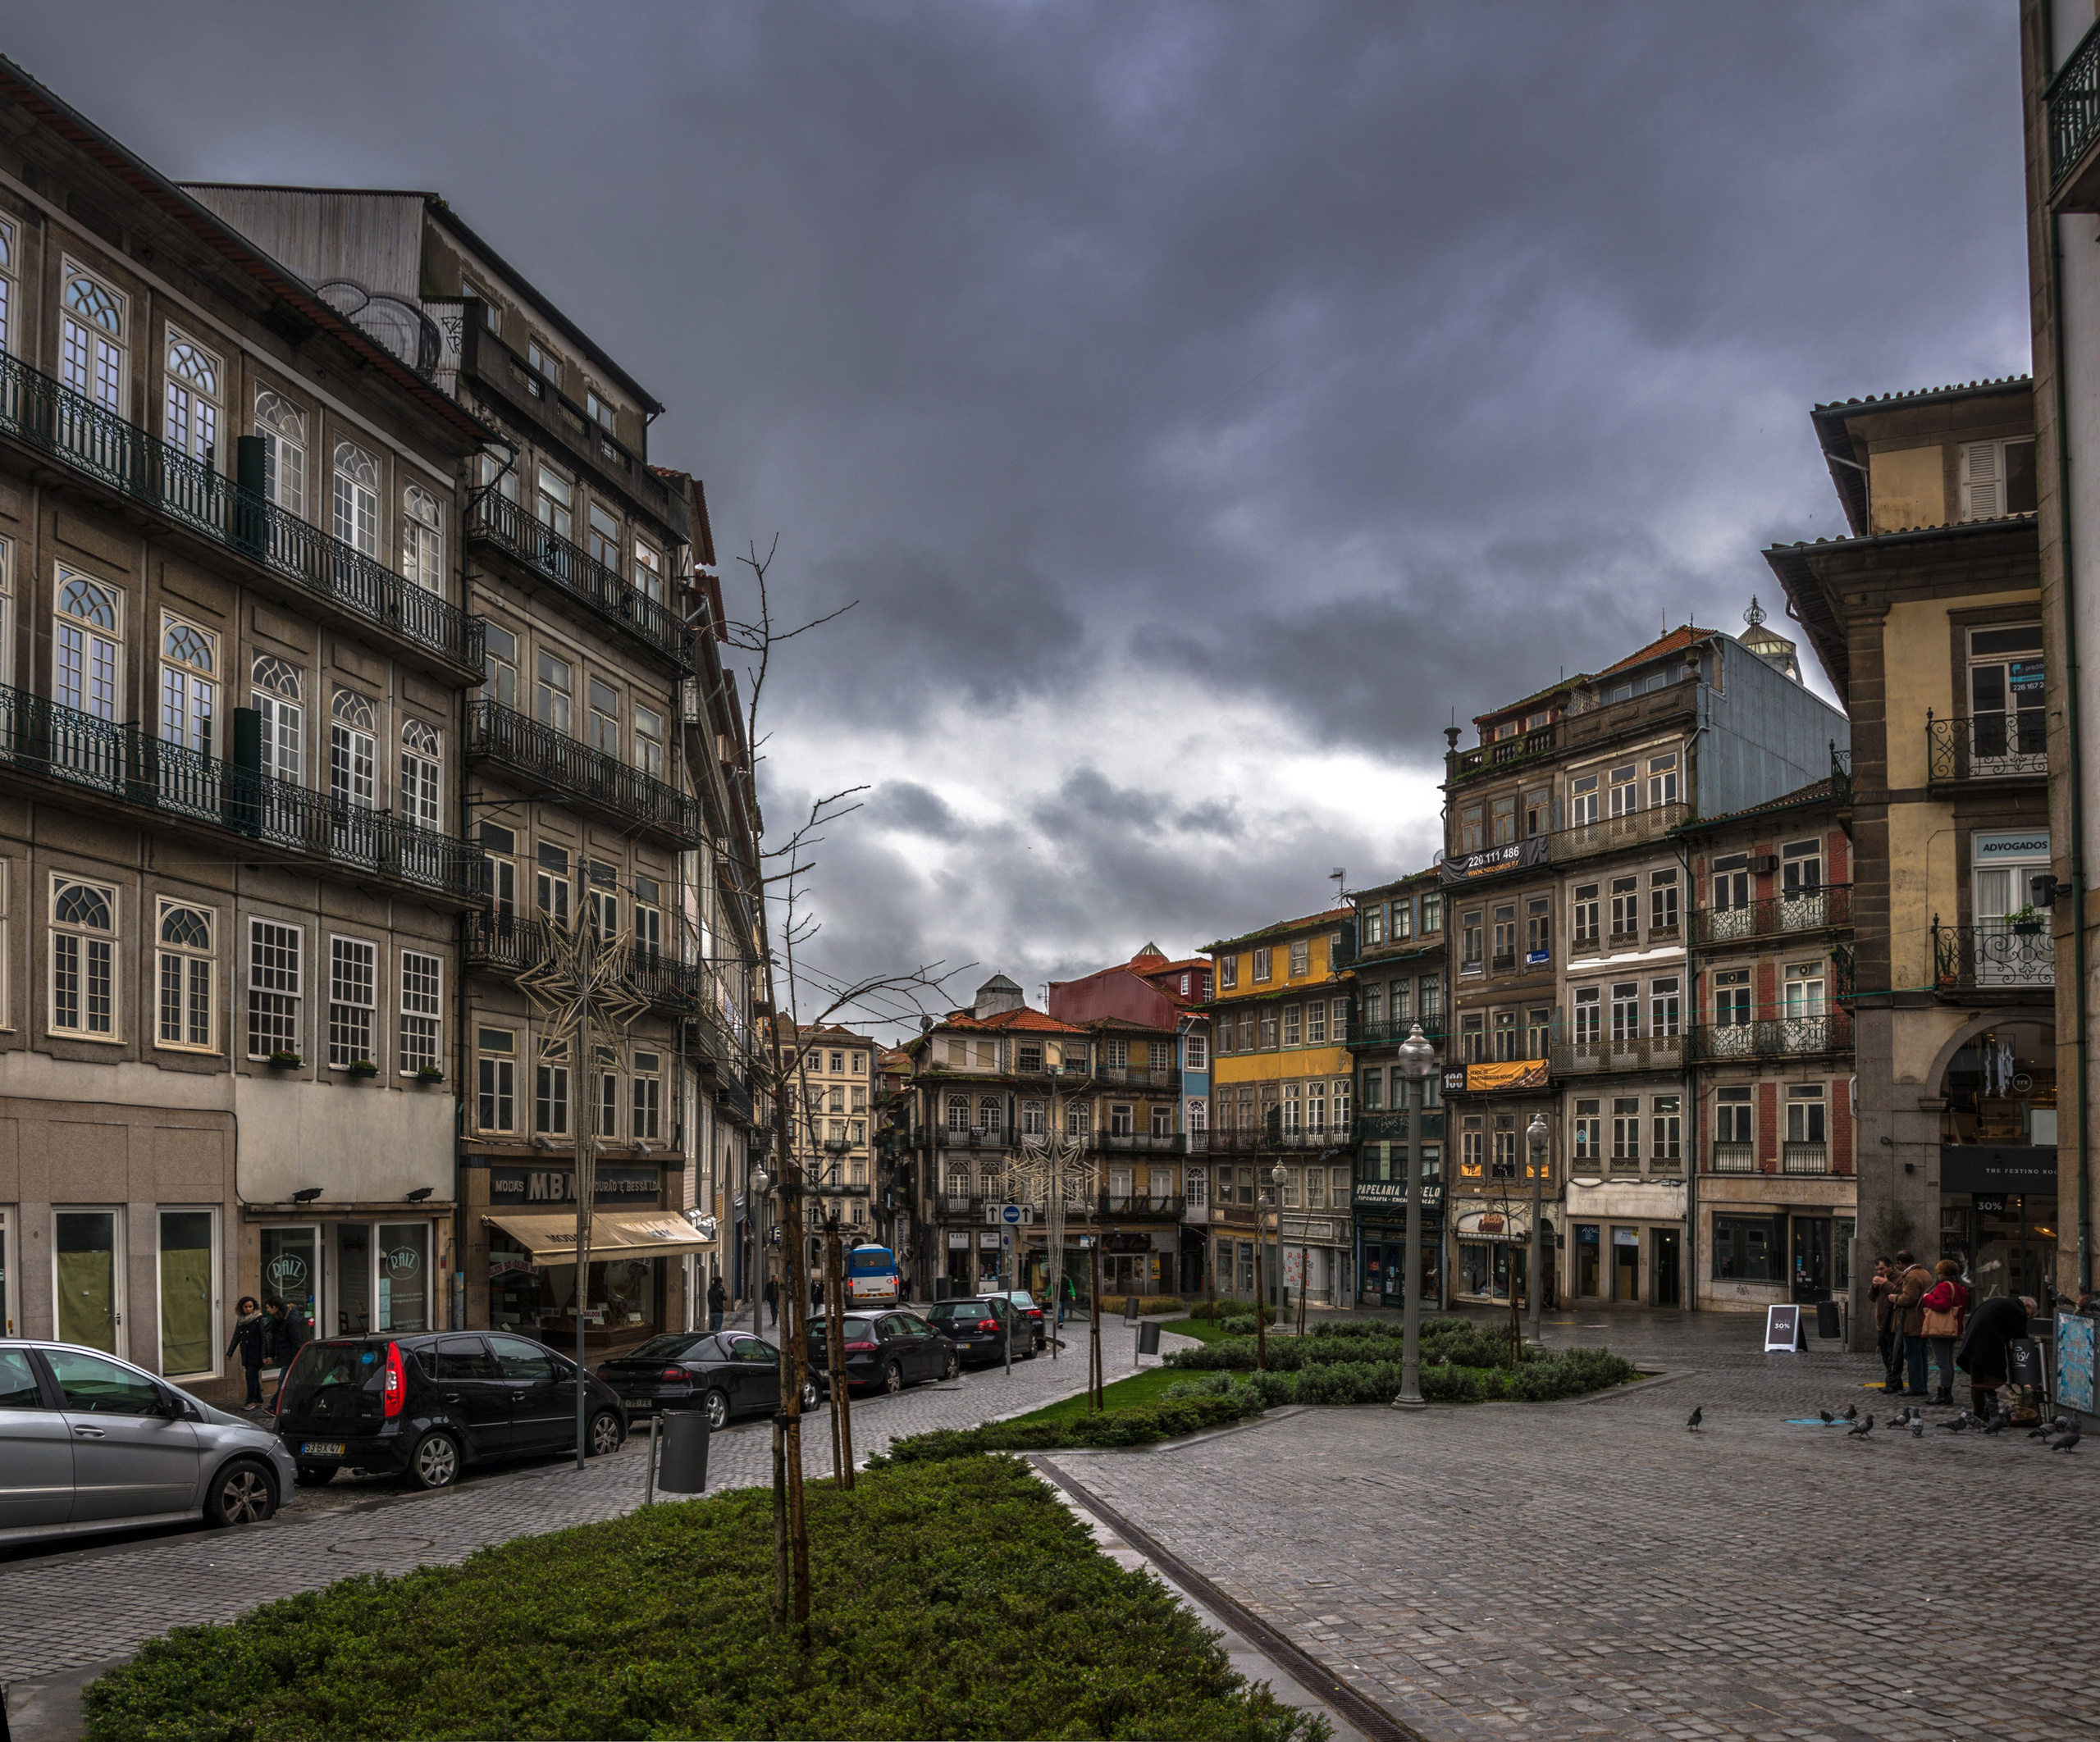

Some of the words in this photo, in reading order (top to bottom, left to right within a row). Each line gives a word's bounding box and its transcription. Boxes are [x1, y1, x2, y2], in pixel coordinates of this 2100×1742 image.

[2025, 663, 2044, 672] predib
[1983, 841, 2048, 851] ADVOGADOS
[1468, 855, 1483, 867] 220
[1486, 850, 1500, 863] 111
[1503, 846, 1519, 859] 486
[495, 1180, 524, 1192] MODAS
[626, 1181, 648, 1192] BESSA
[1357, 1184, 1400, 1196] PAPELARIA
[1405, 1186, 1440, 1197] ELO
[1978, 1202, 2002, 1211] 30%
[545, 1234, 592, 1243] MOD
[390, 1252, 416, 1270] RAIZ
[272, 1260, 302, 1279] RAIZ
